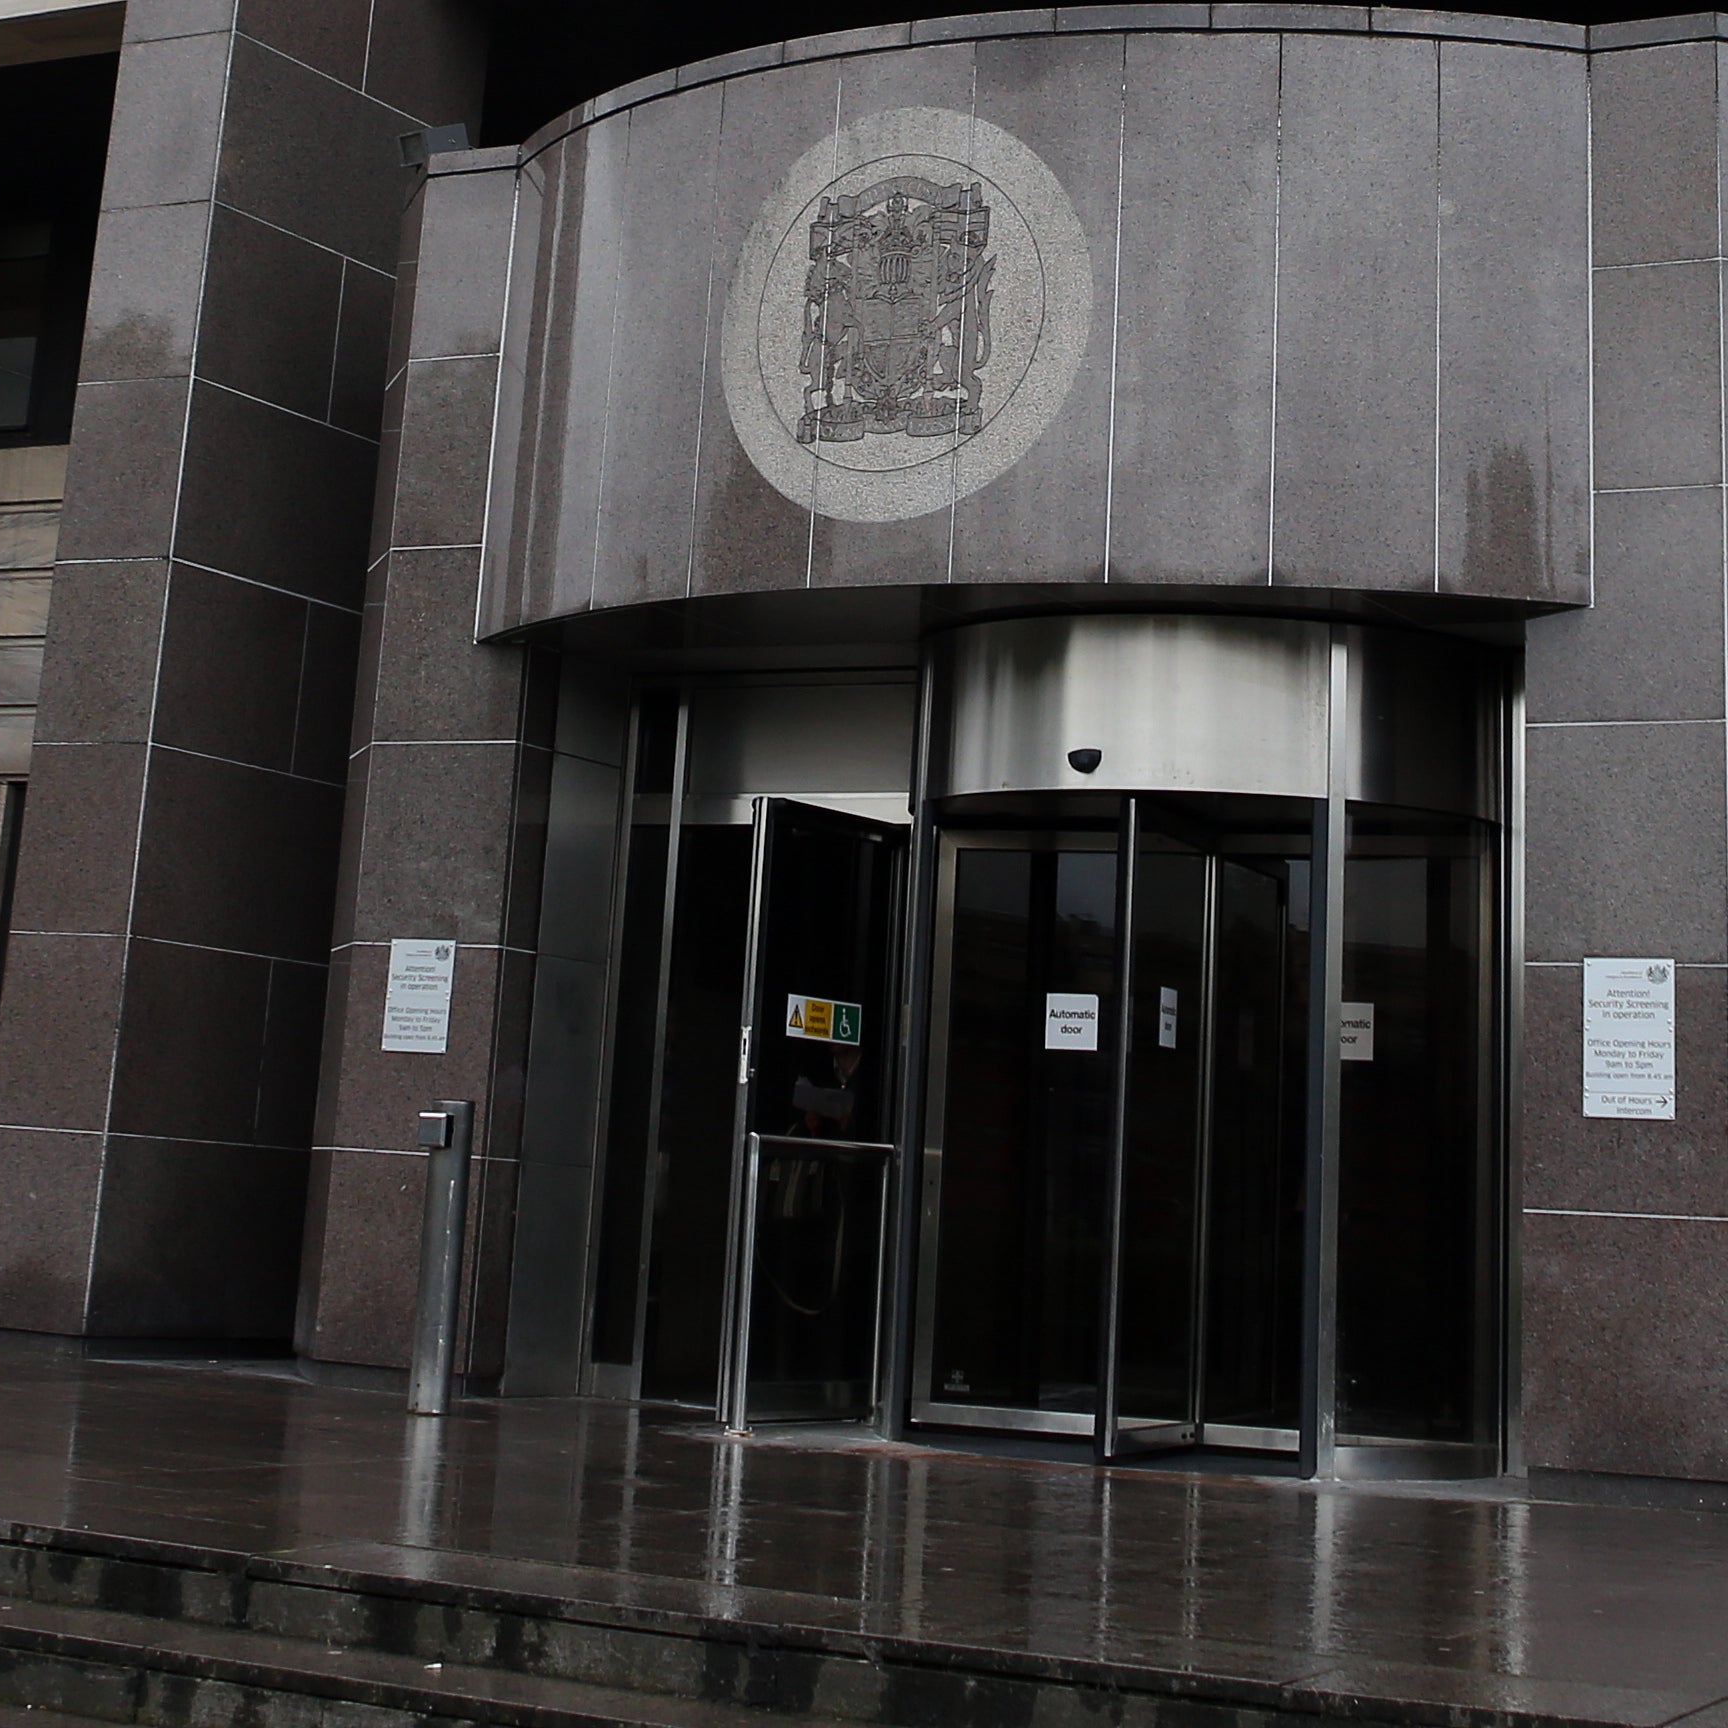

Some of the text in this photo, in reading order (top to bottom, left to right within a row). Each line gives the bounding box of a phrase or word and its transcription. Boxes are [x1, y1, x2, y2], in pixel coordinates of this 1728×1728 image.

[1606, 989, 1650, 998] Attention!
[1588, 999, 1669, 1010] Security Screening
[1049, 1008, 1096, 1020] Automatic
[1613, 1011, 1655, 1019] operation
[1060, 1024, 1083, 1034] door
[1587, 1039, 1672, 1048] Office Opening Hours
[1594, 1050, 1626, 1058] Monday
[1639, 1051, 1664, 1059] Friday
[1635, 1061, 1653, 1069] 5pm
[1601, 1095, 1652, 1104] Out of Hours
[1616, 1106, 1652, 1115] Intercom
